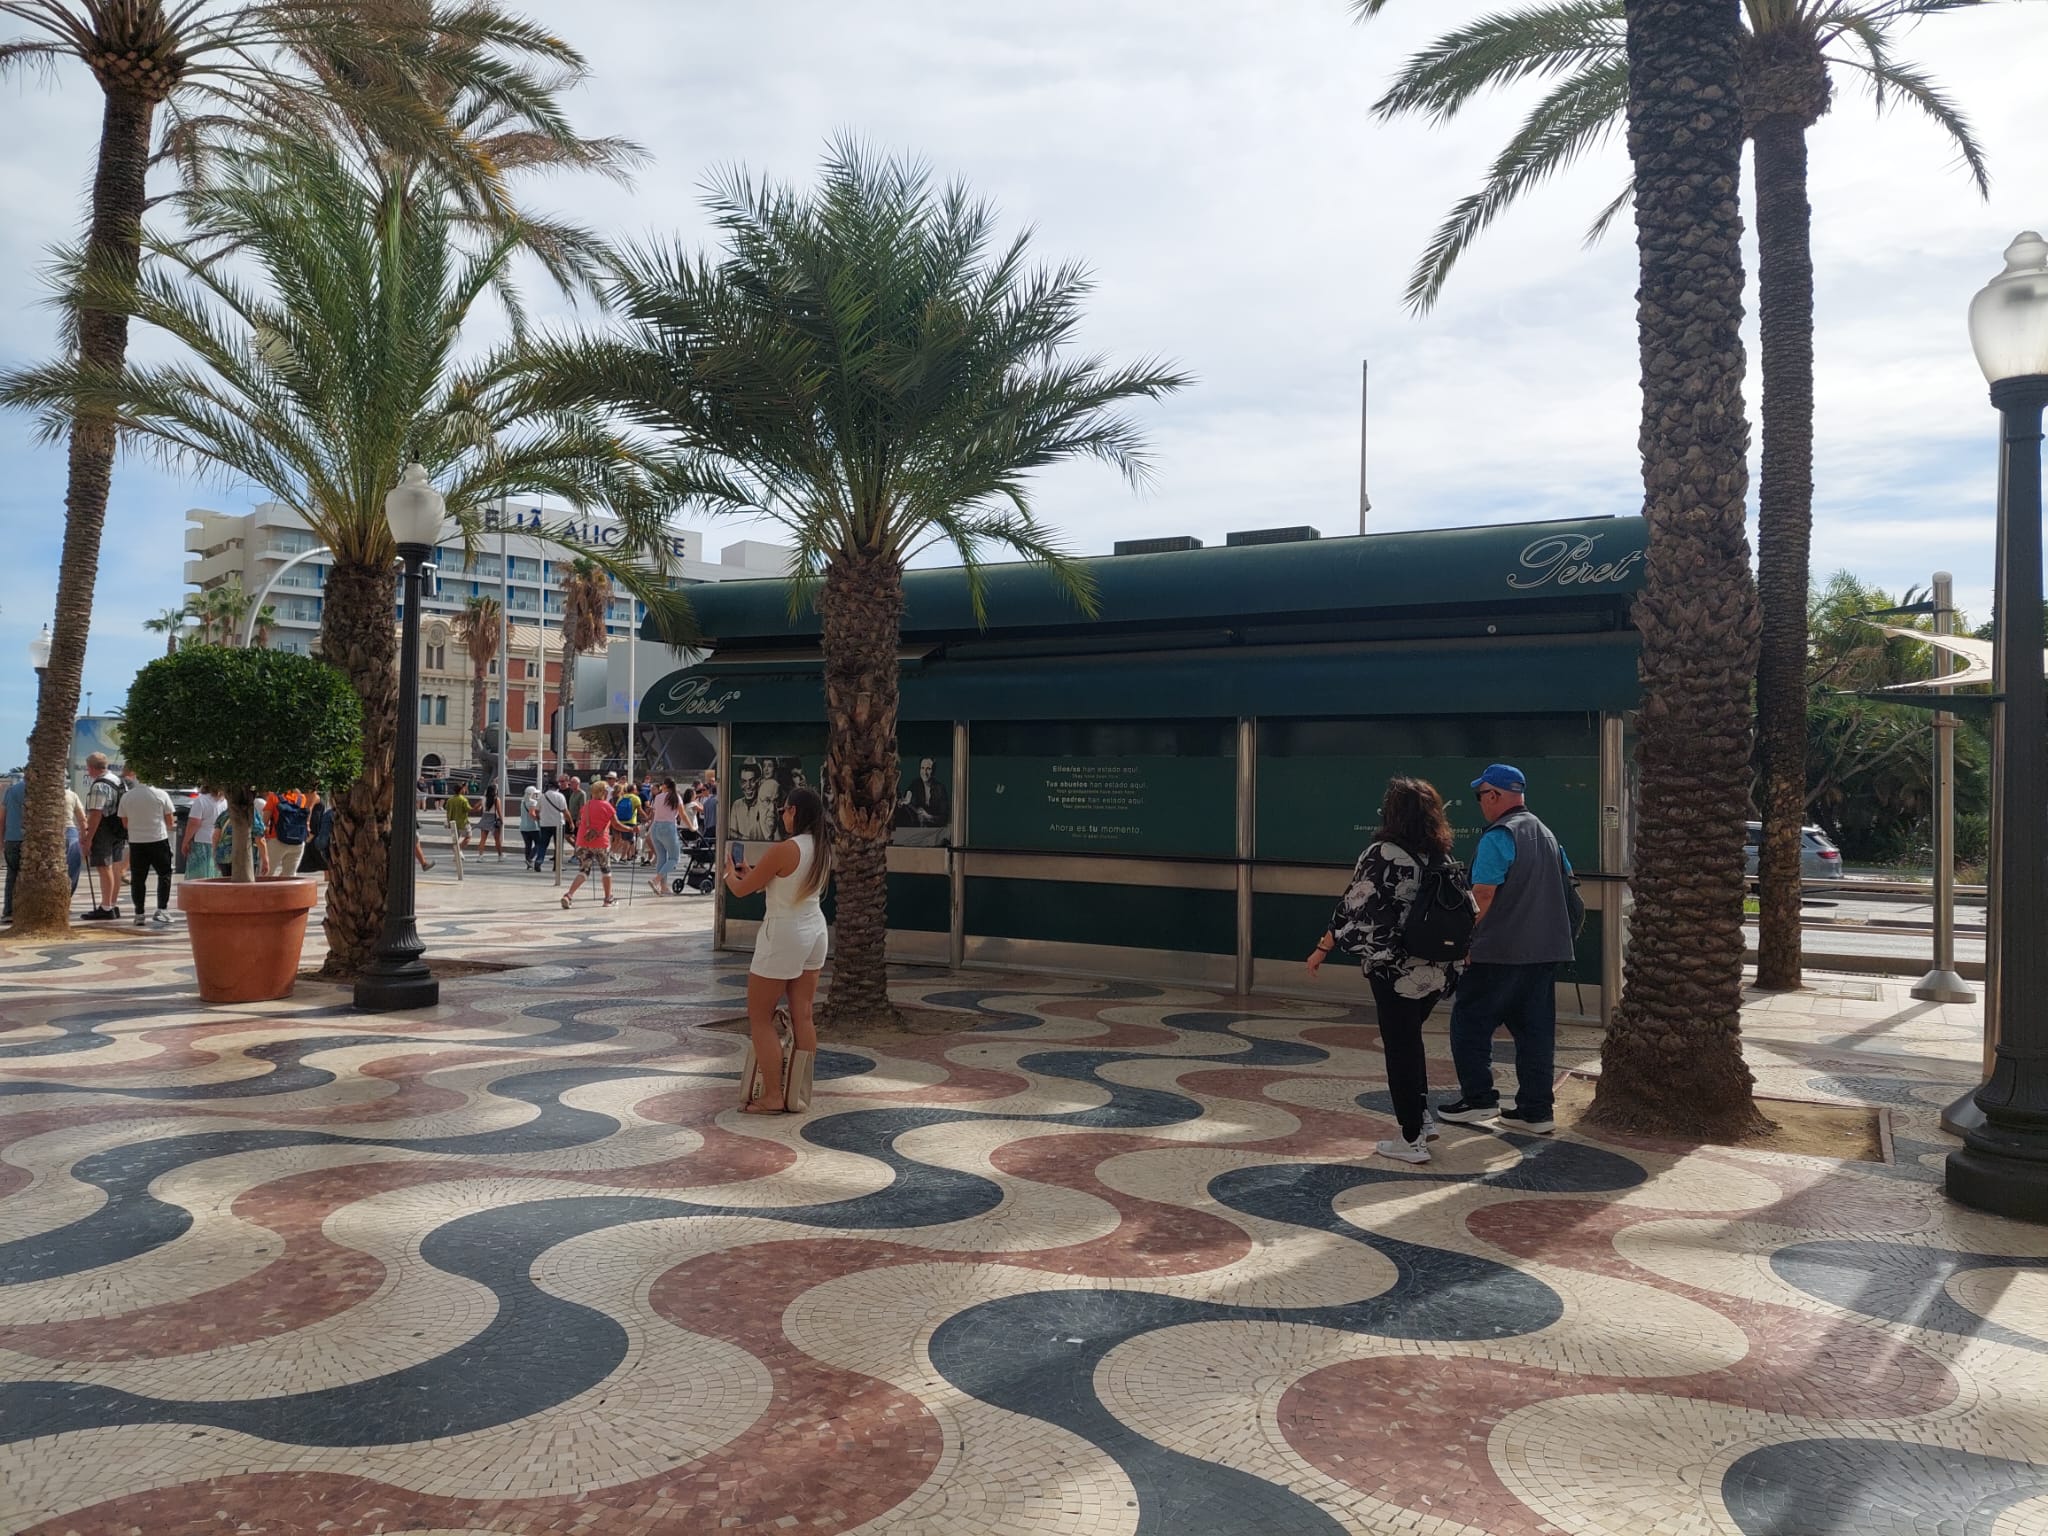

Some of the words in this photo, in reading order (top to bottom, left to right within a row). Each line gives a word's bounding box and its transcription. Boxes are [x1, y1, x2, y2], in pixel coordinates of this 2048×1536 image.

[562, 521, 685, 557] ALICE
[1506, 533, 1642, 589] Peret
[659, 675, 733, 716] Peret
[1049, 823, 1074, 832] Ahora
[1089, 824, 1098, 833] tu
